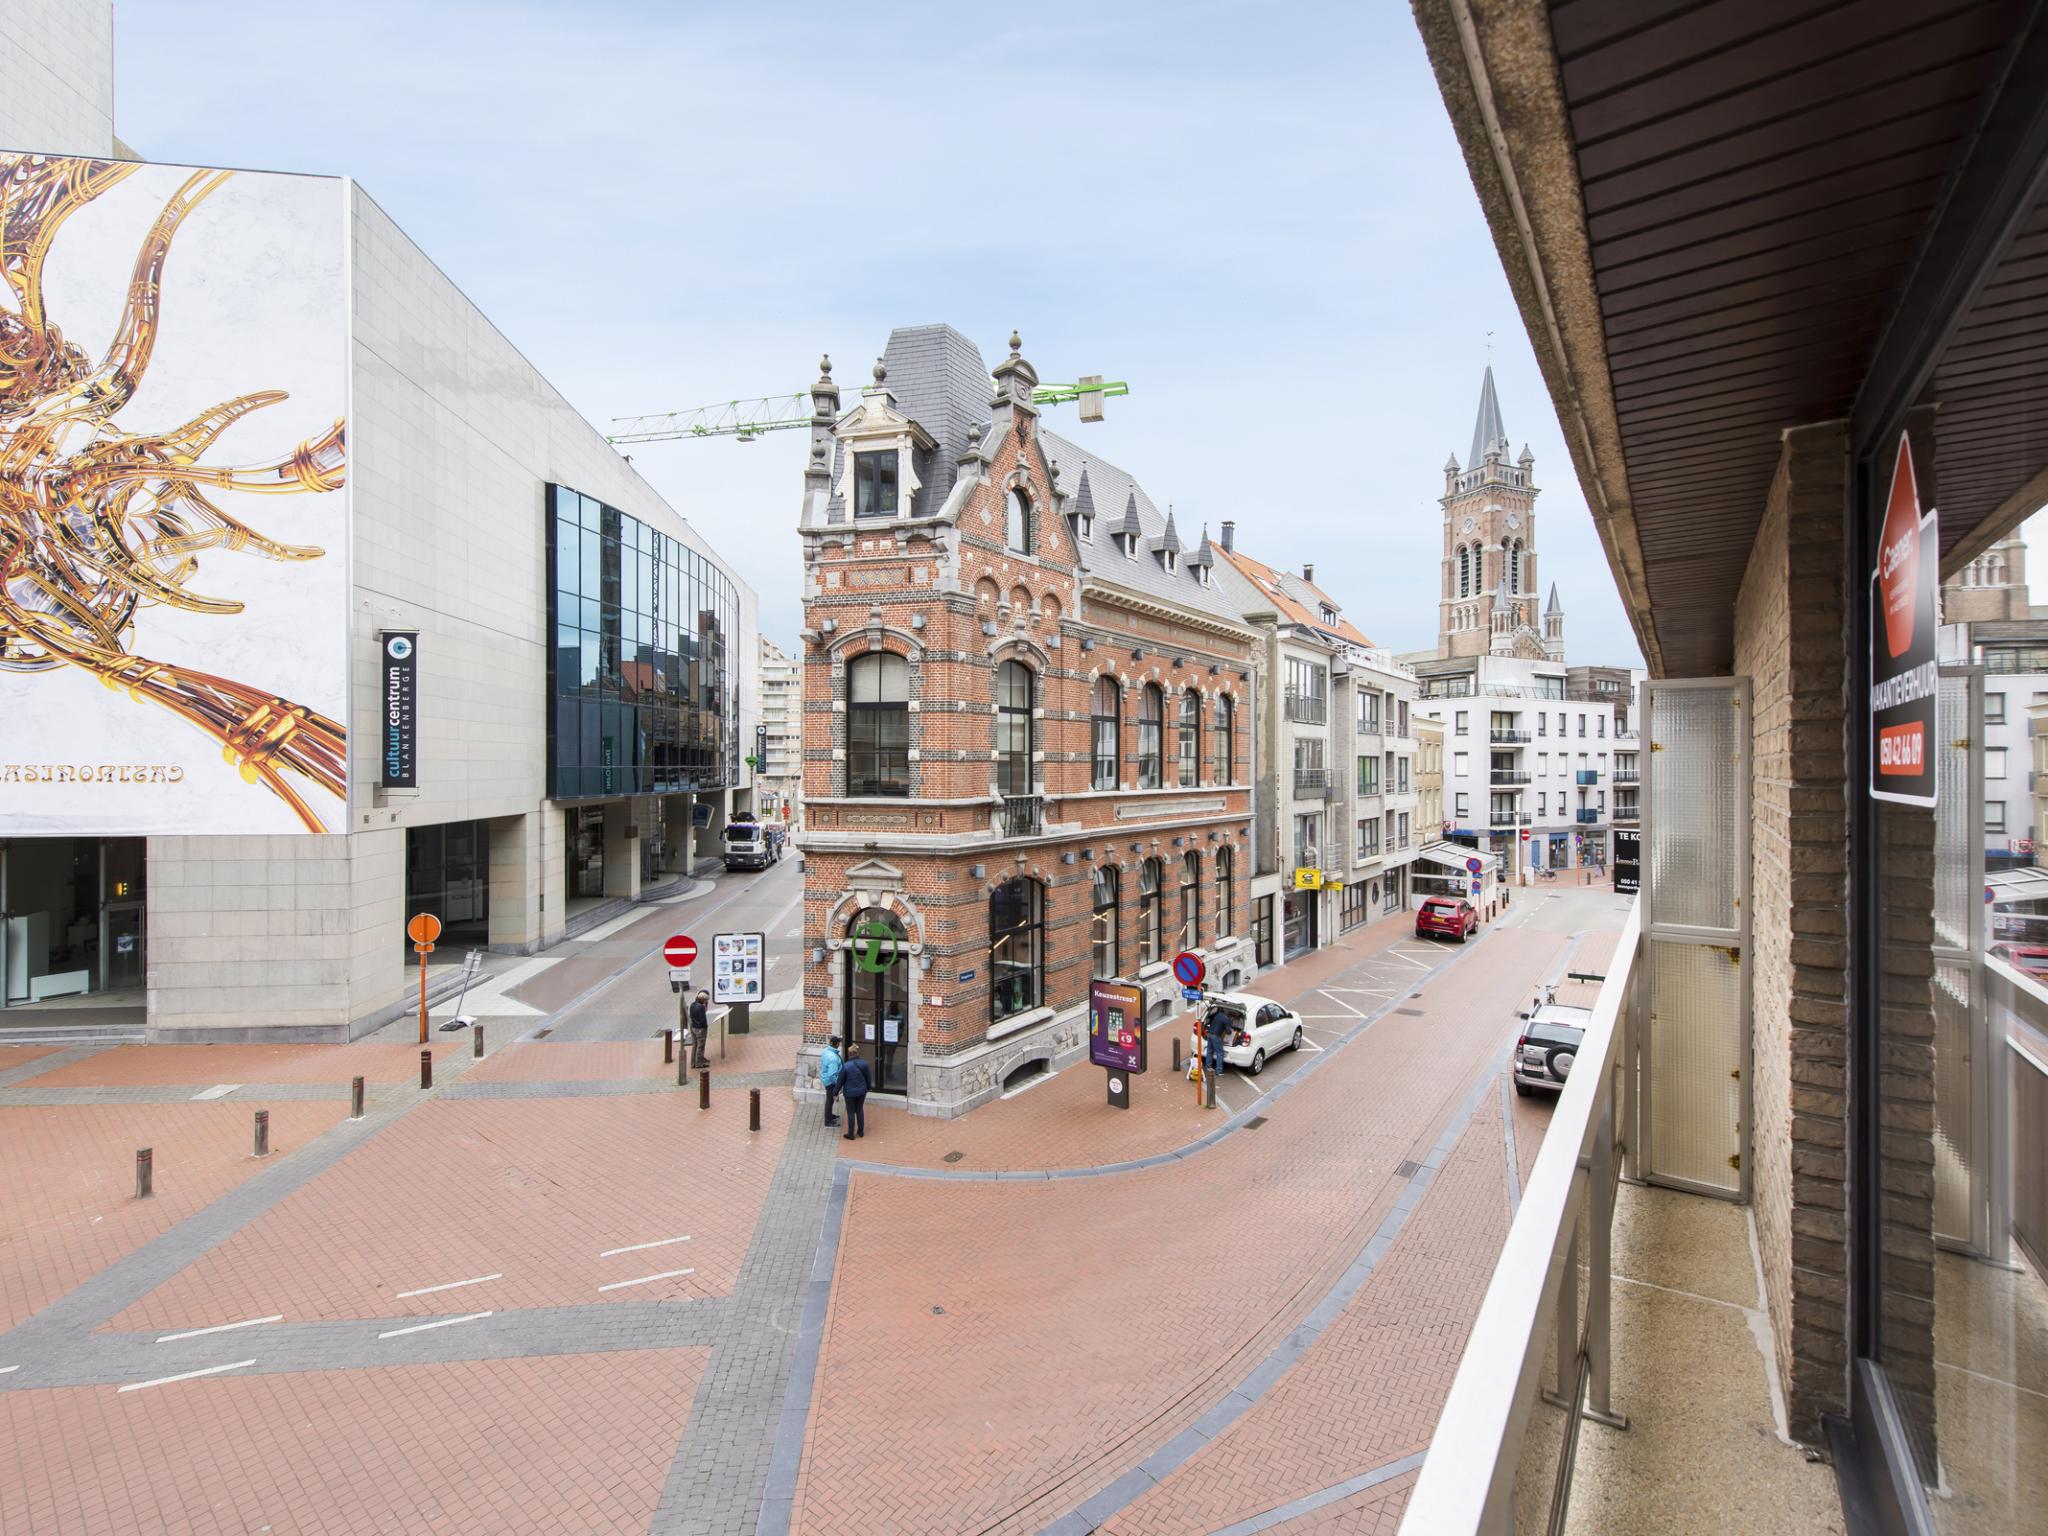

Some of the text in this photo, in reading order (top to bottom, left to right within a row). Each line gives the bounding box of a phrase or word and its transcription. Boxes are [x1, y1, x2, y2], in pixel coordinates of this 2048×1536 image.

[386, 667, 400, 777] cultuurcentrum
[402, 667, 410, 777] BLANKENBERGE
[1892, 735, 1901, 766] 42
[1902, 734, 1911, 765] 66
[1619, 832, 1629, 840] TE
